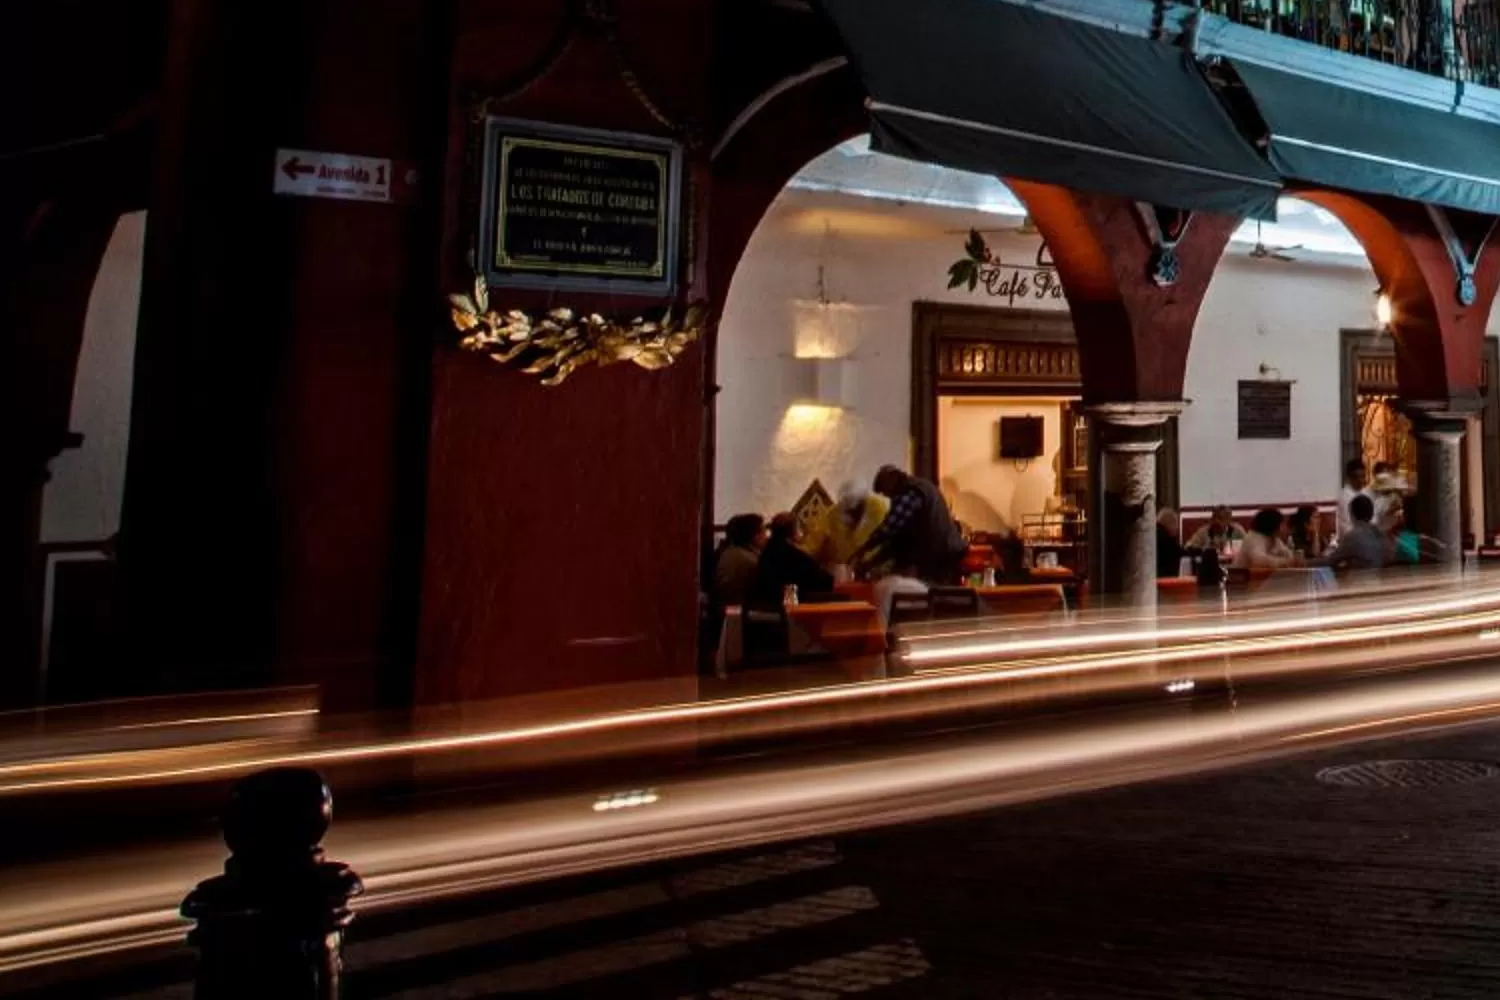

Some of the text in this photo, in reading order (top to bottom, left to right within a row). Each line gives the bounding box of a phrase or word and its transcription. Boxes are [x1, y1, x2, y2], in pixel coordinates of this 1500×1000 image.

[318, 164, 385, 185] Avenida 1
[511, 184, 533, 200] LOS
[591, 191, 604, 209] DE
[980, 268, 1062, 308] Café Pa
